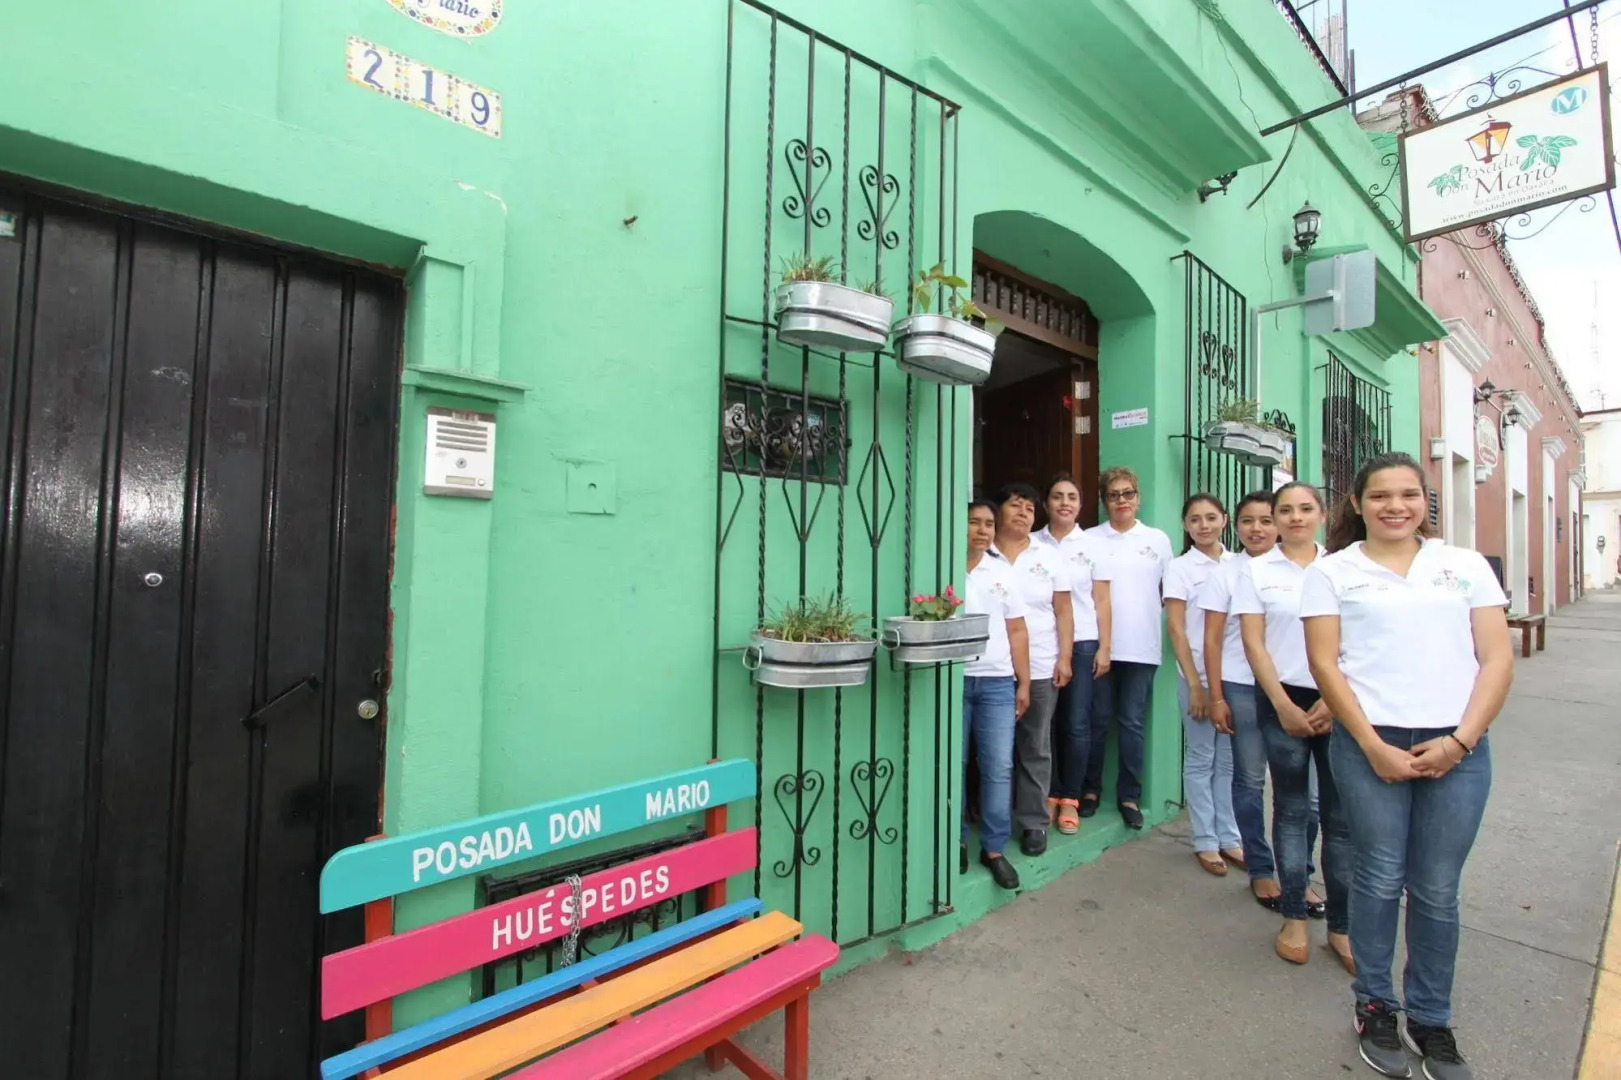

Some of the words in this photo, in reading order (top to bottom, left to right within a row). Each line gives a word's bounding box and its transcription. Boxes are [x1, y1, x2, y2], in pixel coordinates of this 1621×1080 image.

[363, 49, 490, 126] 219
[1556, 88, 1583, 113] M
[1457, 153, 1520, 182] Posada
[1474, 162, 1558, 198] Mario
[1440, 182, 1469, 198] Don
[1441, 184, 1568, 224] www.posadadonmario.com
[412, 821, 533, 883] POSADA
[549, 804, 602, 845] DON
[645, 779, 711, 820] MARIO
[492, 865, 671, 950] HUÉSPEDES
